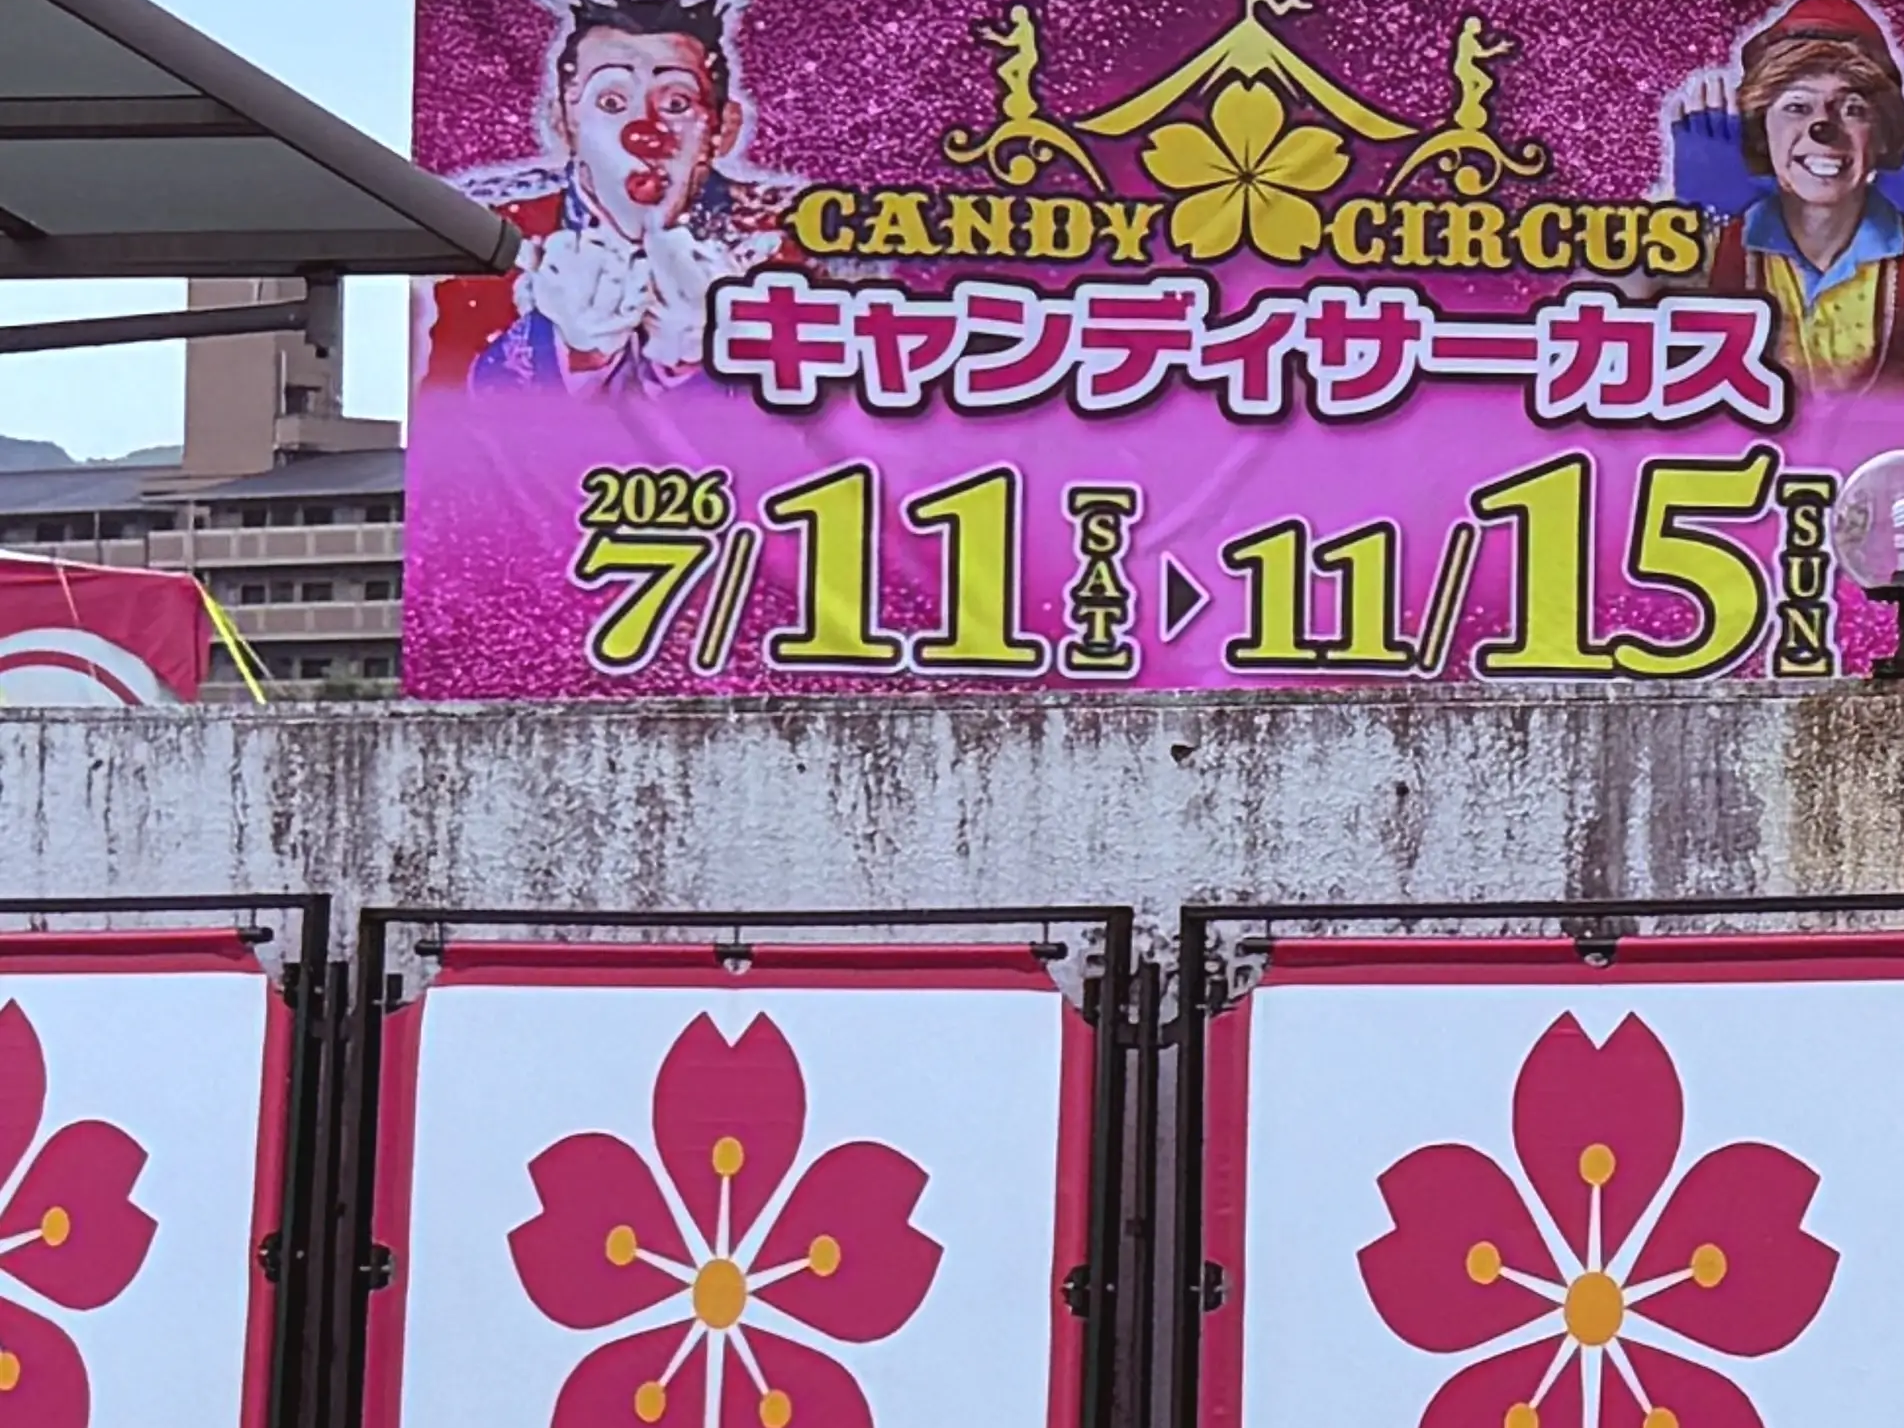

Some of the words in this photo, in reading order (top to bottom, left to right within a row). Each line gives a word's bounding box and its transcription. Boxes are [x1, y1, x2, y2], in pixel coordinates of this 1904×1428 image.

[786, 187, 1164, 262] CANDY
[1323, 199, 1700, 273] CIRCUS
[722, 282, 1777, 416] キャンディサーカス
[583, 470, 727, 526] 2026
[580, 470, 1039, 666] 7/11
[1231, 453, 1773, 670] 11/15
